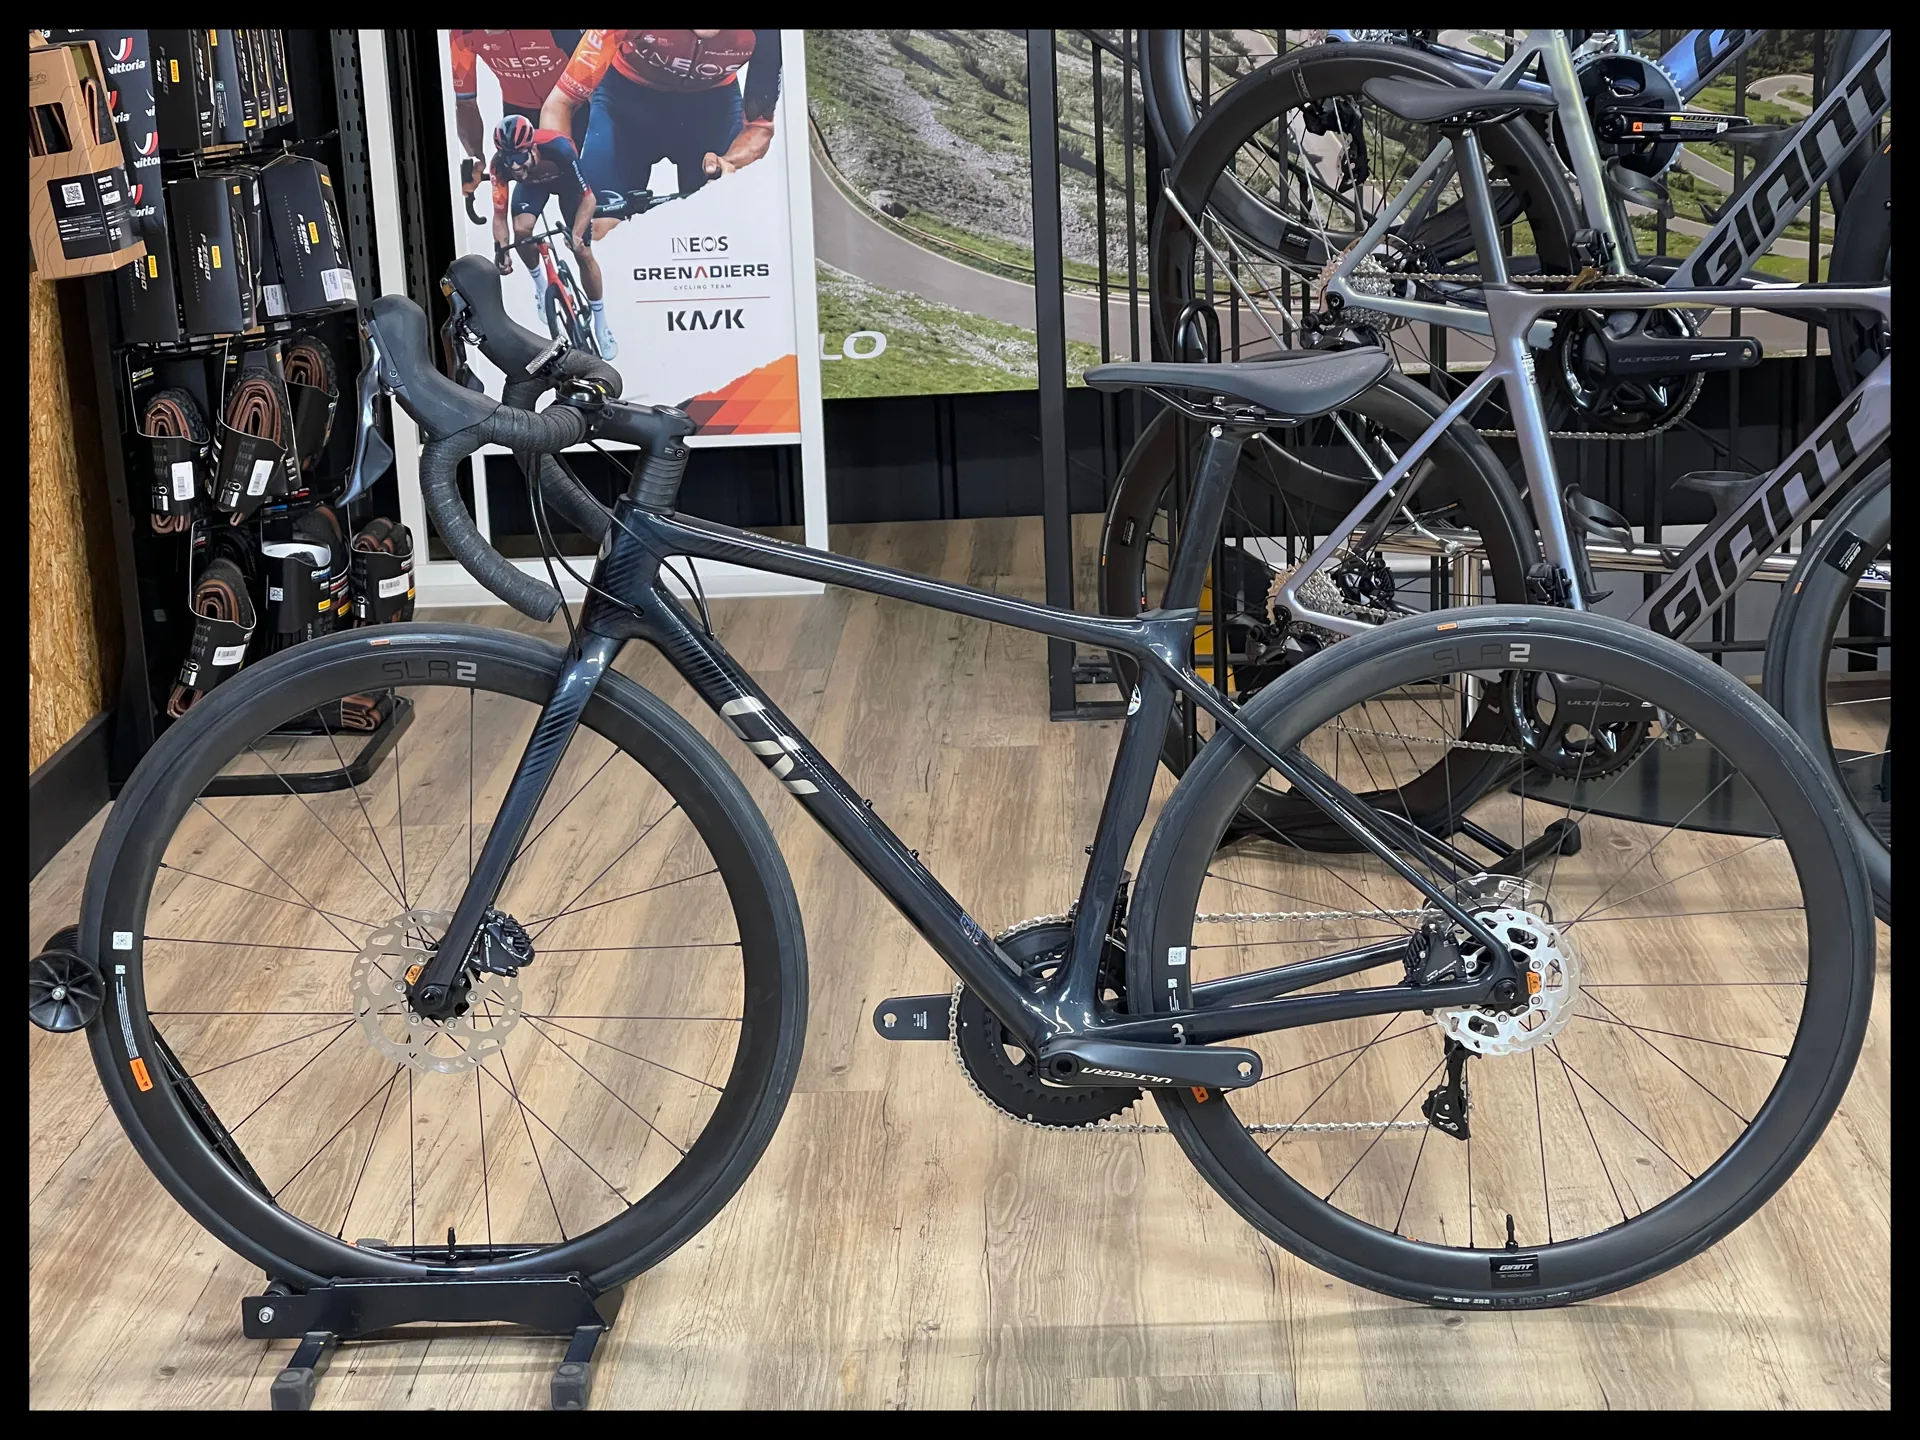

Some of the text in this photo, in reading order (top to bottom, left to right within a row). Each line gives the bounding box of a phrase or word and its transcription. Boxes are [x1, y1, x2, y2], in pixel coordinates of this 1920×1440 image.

[107, 59, 146, 75] vittoria
[490, 55, 551, 69] INEOS
[1692, 35, 1891, 287] GIANT
[671, 236, 729, 253] INEOS
[633, 263, 770, 281] GRENADIERS
[667, 308, 745, 332] KASK
[1618, 355, 1680, 364] ULTEGRA
[1649, 390, 1865, 639] GIANT
[1433, 643, 1531, 668] SLR 2
[382, 660, 477, 681] SLR 2
[1567, 699, 1630, 707] ULTEGRA
[1171, 1023, 1187, 1047] 3
[1081, 1067, 1173, 1085] ULTEGRA
[1499, 1263, 1533, 1271] GIANT
